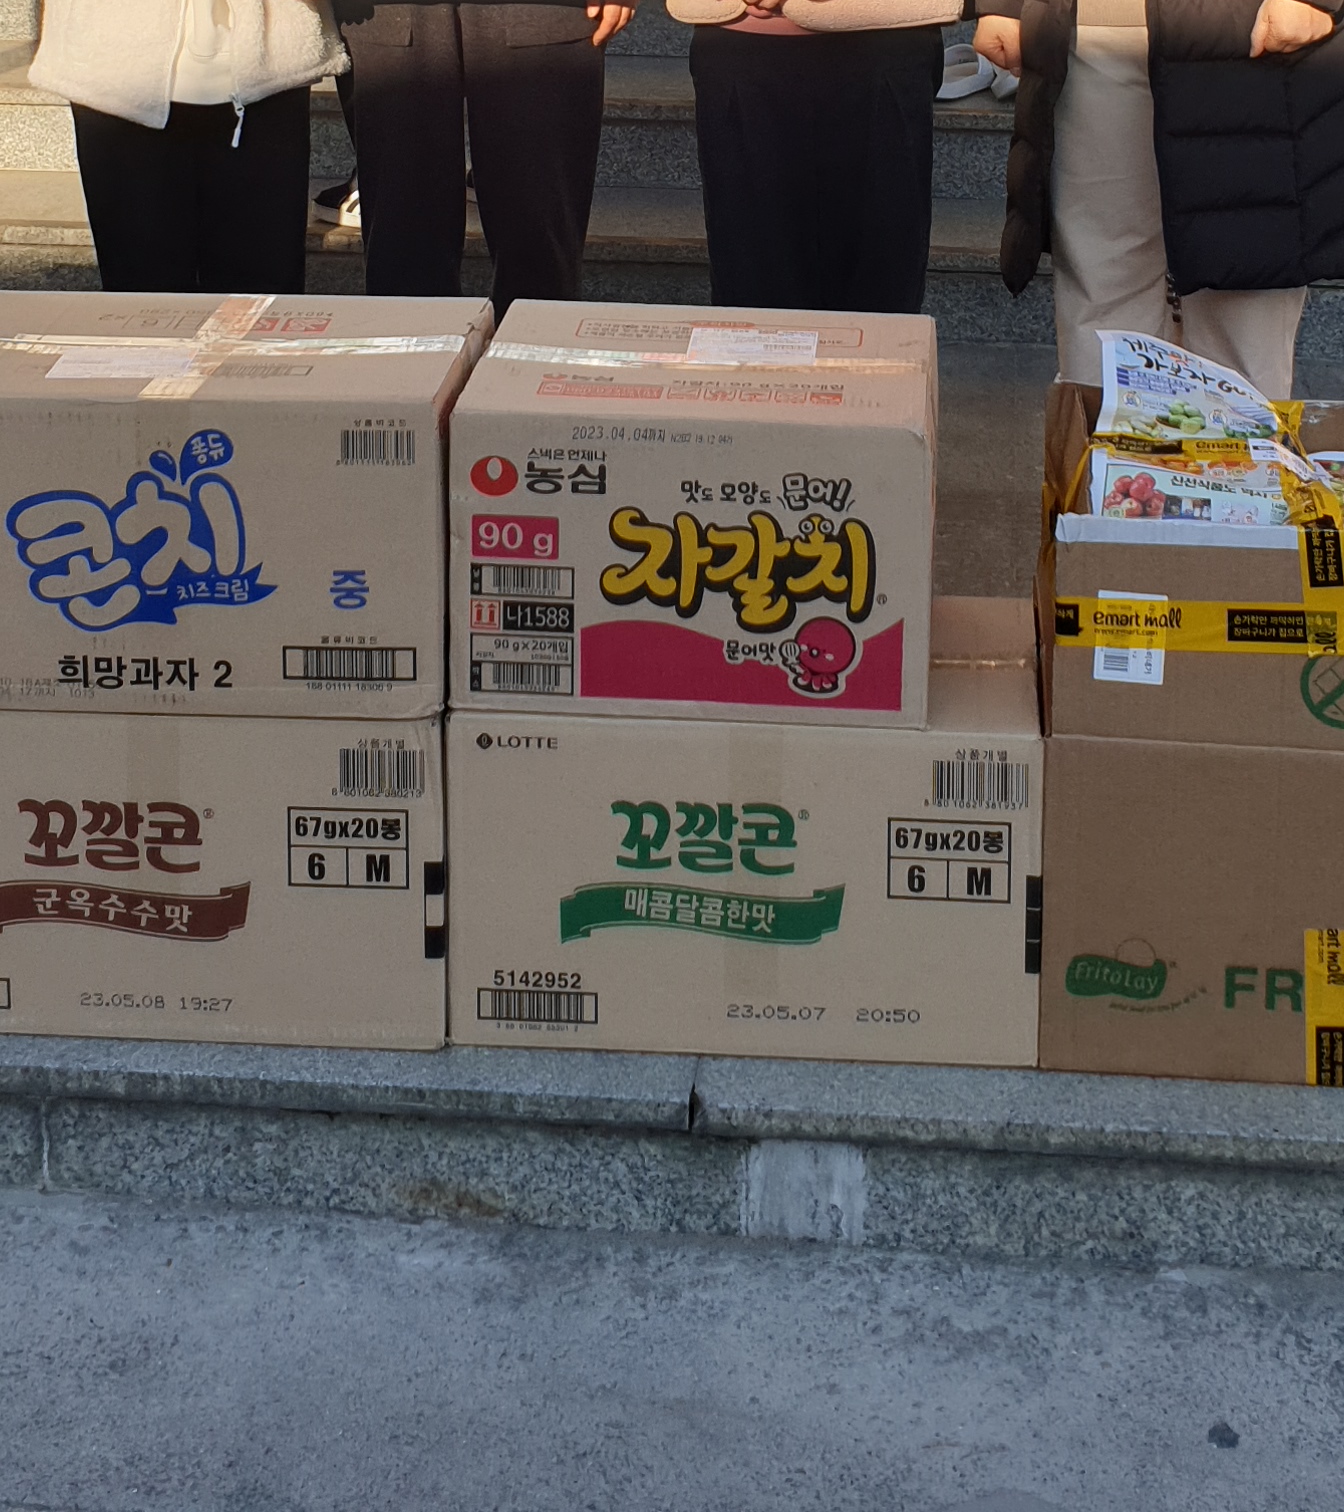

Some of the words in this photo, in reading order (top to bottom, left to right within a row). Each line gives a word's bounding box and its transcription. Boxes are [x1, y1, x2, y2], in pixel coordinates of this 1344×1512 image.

[191, 433, 225, 465] 퐁듀
[568, 449, 607, 462] 언제나
[1196, 440, 1240, 451] emart
[524, 461, 607, 496] 농심
[681, 480, 713, 503] 맛도
[720, 481, 772, 504] 모양도
[5, 471, 247, 632] 콘치
[478, 521, 523, 550] 90
[532, 531, 554, 557] g
[600, 506, 876, 633] 자갈치
[329, 570, 370, 610] 중
[507, 605, 570, 628] 나1588
[1093, 609, 1140, 627] emart
[1144, 605, 1182, 629] mall
[1233, 614, 1268, 626] 손가락만
[1233, 627, 1276, 637] 장바구니가
[1279, 628, 1304, 638] 집으로
[725, 640, 776, 662] 문어맛
[58, 655, 199, 691] 희망과자
[213, 661, 233, 688] 2
[497, 736, 558, 749] LOTTE
[17, 798, 203, 873] 꼬깔콘
[610, 800, 797, 876] 꼬깔콘
[307, 853, 325, 880] 6
[366, 854, 391, 882] M
[907, 865, 926, 893] 6
[966, 867, 992, 896] M
[33, 889, 193, 932] 군옥수수맛
[624, 888, 775, 933] 매콤달콤한맛
[493, 970, 581, 989] 5142952
[80, 992, 165, 1009] 23.05.08
[179, 997, 233, 1011] 19:27
[727, 1005, 826, 1021] 23.05.07
[856, 1008, 920, 1023] 20:50
